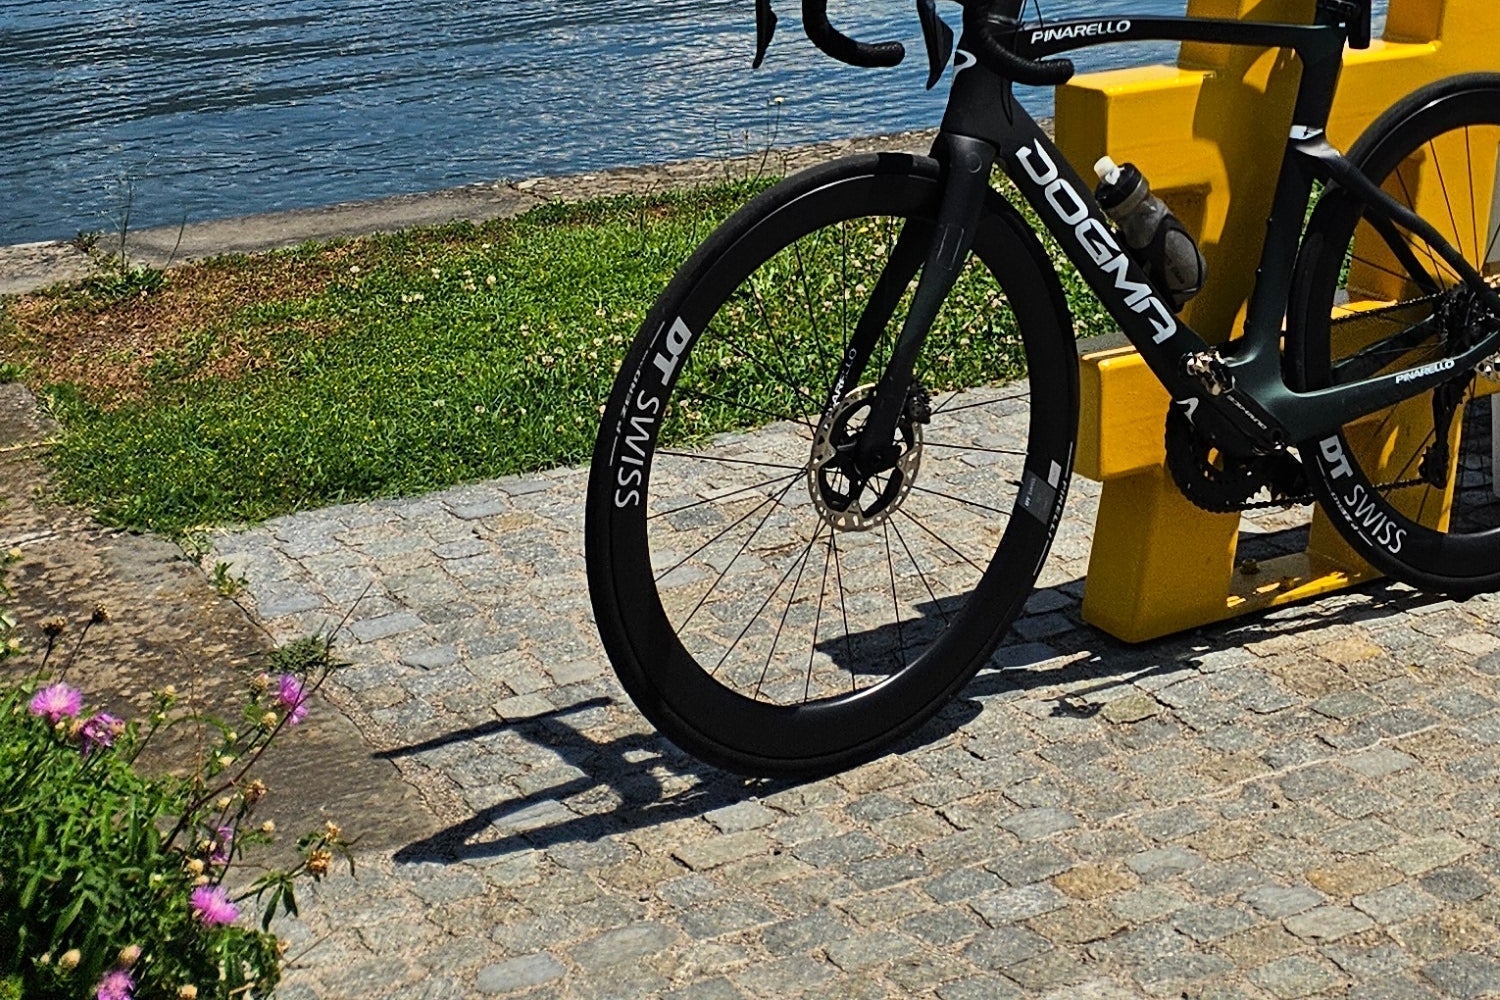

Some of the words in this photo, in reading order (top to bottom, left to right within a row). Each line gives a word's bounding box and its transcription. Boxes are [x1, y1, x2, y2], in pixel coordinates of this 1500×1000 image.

[1030, 20, 1131, 45] PINARELLO
[1015, 137, 1178, 345] DOGMA
[653, 316, 693, 387] DT
[1395, 359, 1455, 384] PINARELLO
[614, 389, 660, 508] SWISS
[1319, 434, 1354, 480] DT
[1343, 483, 1408, 554] SWISS
